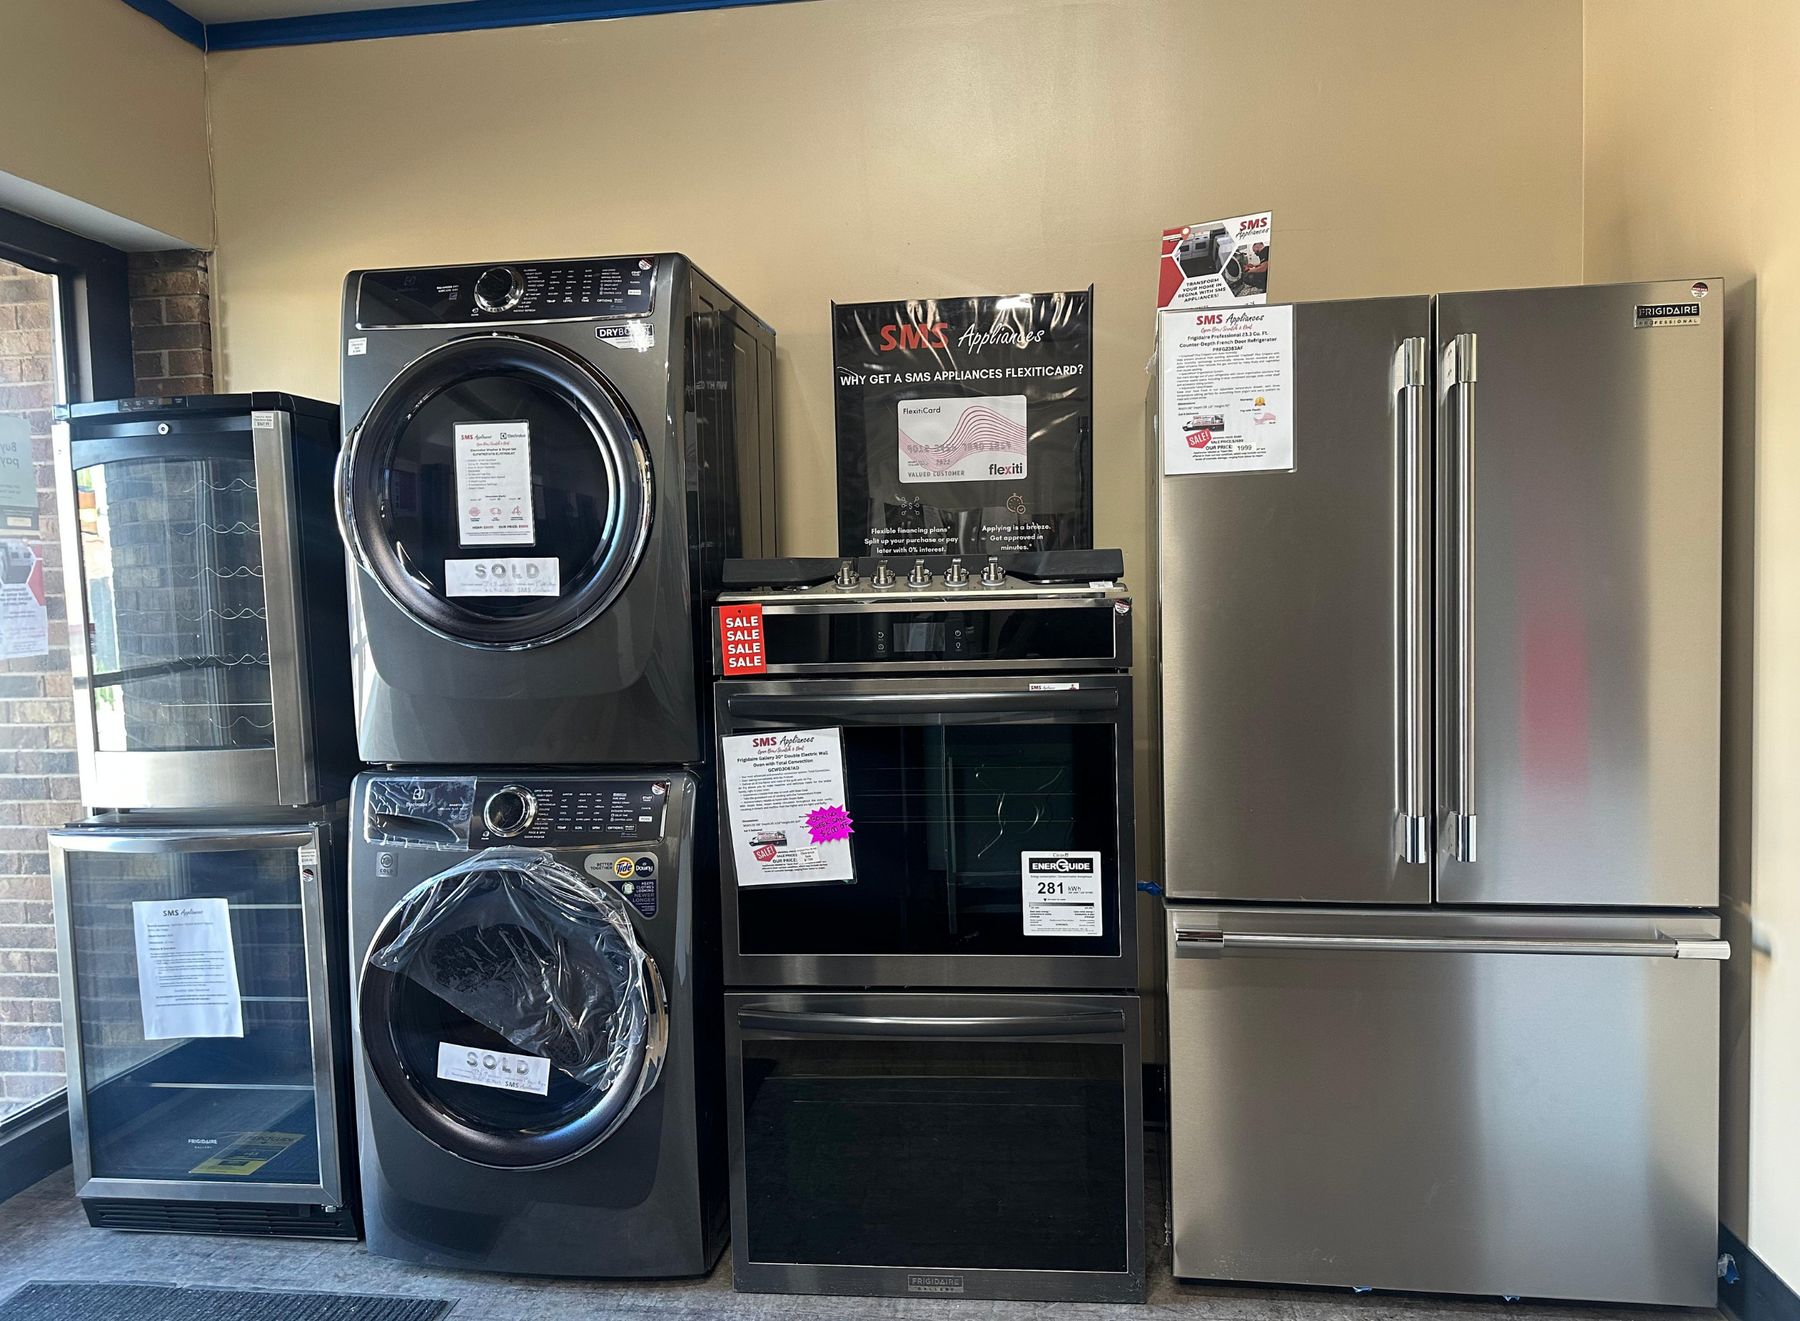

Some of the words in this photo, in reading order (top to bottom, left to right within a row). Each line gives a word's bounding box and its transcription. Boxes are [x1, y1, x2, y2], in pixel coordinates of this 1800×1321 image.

[1240, 217, 1268, 232] SMS
[1236, 228, 1270, 240] Appliances
[1186, 278, 1220, 287] TRANSFORM
[1184, 294, 1219, 302] APPLIANCES!
[1638, 306, 1697, 316] FRIGIDAIRE
[1196, 314, 1223, 325] SMS
[1225, 312, 1264, 326] Appliances
[880, 322, 949, 351] SMS
[958, 323, 1045, 354] Appliances
[840, 375, 866, 386] WHY
[870, 373, 892, 384] GET
[894, 373, 902, 383] A
[905, 371, 931, 382] SMS
[933, 369, 1003, 381] APPLIANCES
[1006, 364, 1084, 378] FLEXITICARD?
[903, 406, 940, 414] FlexitiCard
[1189, 431, 1209, 445] SALE!
[989, 463, 1022, 475] flexiti
[897, 526, 928, 535] financing
[982, 524, 1011, 533] Applying
[864, 537, 880, 545] Split
[1003, 534, 1036, 542] approved
[475, 563, 540, 579] SOLD
[726, 616, 758, 628] SALE
[727, 629, 760, 641] SALE
[728, 643, 760, 654] SALE
[729, 656, 762, 668] SALE
[752, 737, 777, 748] SMS
[780, 735, 814, 747] Appliances
[810, 812, 837, 822] BOXING
[813, 820, 830, 830] WEEK
[756, 846, 774, 859] SALE!
[616, 863, 632, 874] Tide
[1032, 859, 1090, 872] ENERGUIDE
[1038, 882, 1063, 894] 281
[467, 1051, 529, 1075] SOLD
